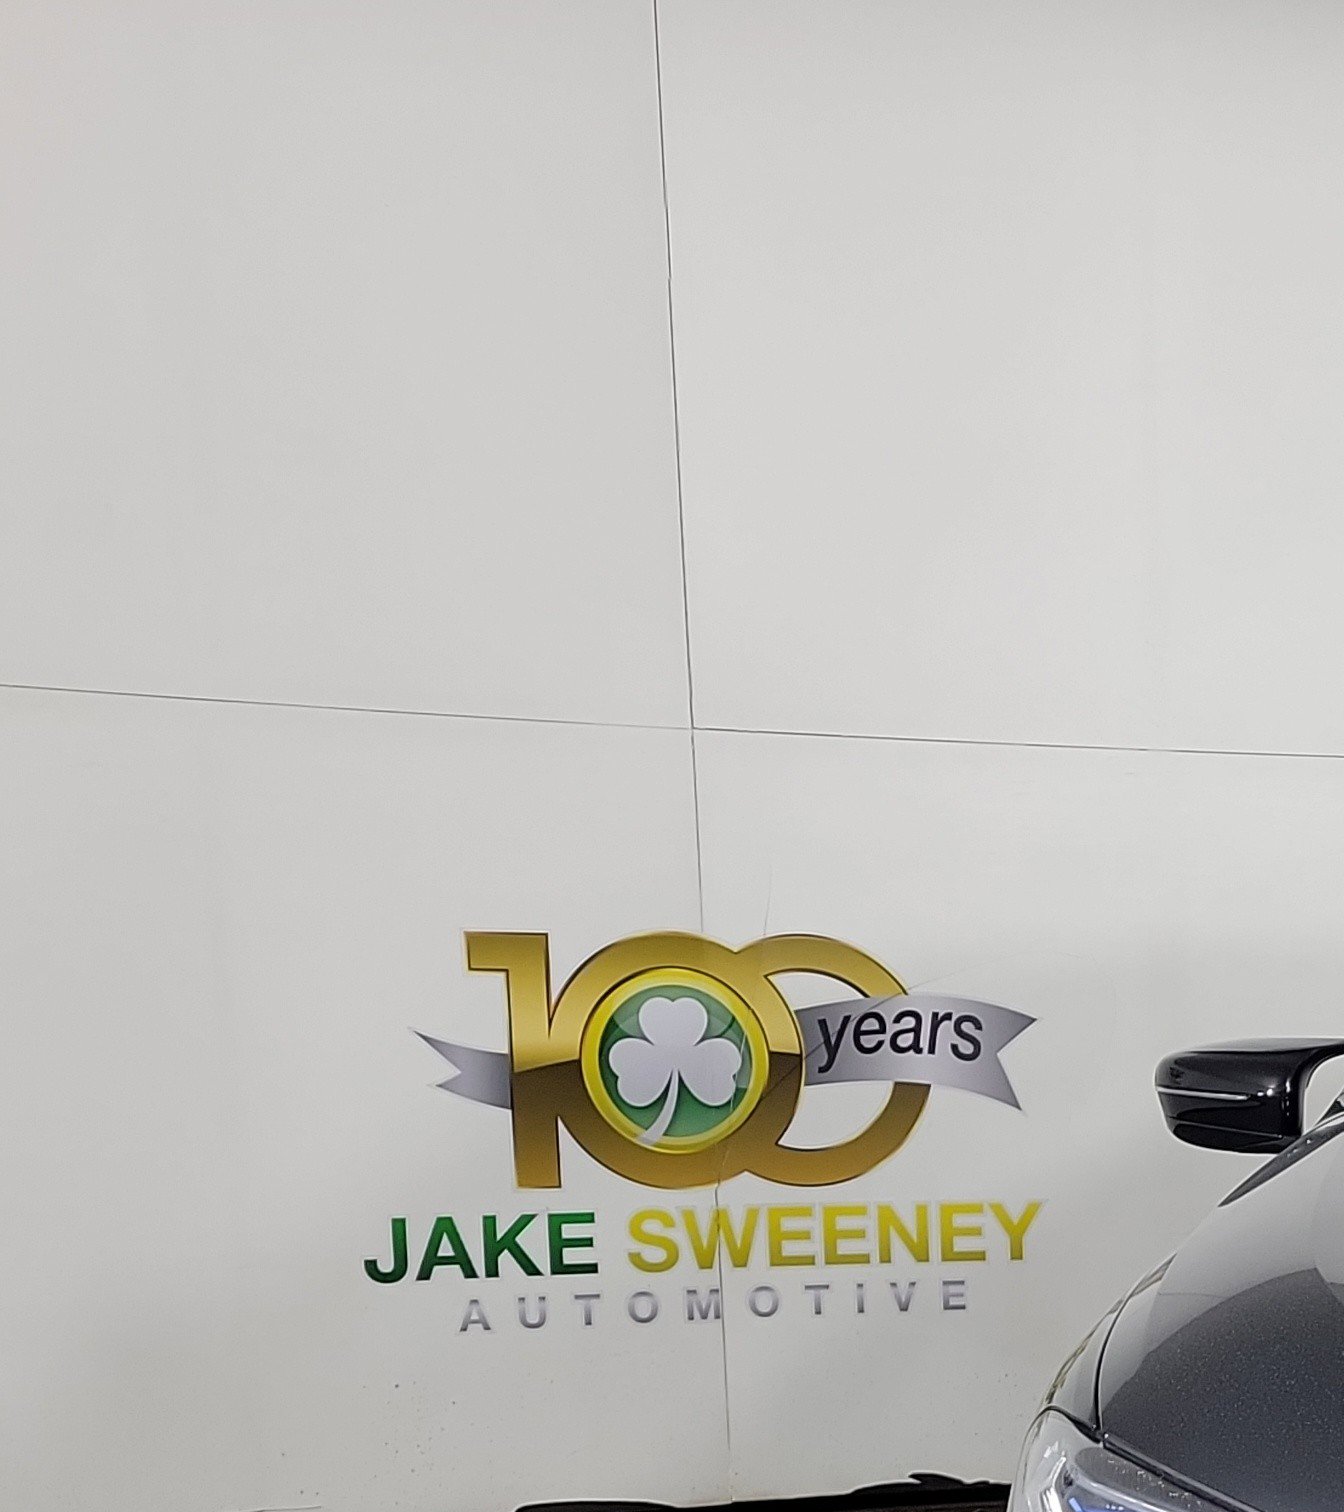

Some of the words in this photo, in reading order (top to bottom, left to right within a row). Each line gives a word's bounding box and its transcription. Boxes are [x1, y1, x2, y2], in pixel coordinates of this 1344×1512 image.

[463, 931, 931, 1189] 100
[816, 1009, 984, 1074] years
[363, 1211, 600, 1284] JAKE
[627, 1201, 1043, 1273] SWEENEY
[458, 1279, 968, 1333] AUTOMOTIVE
